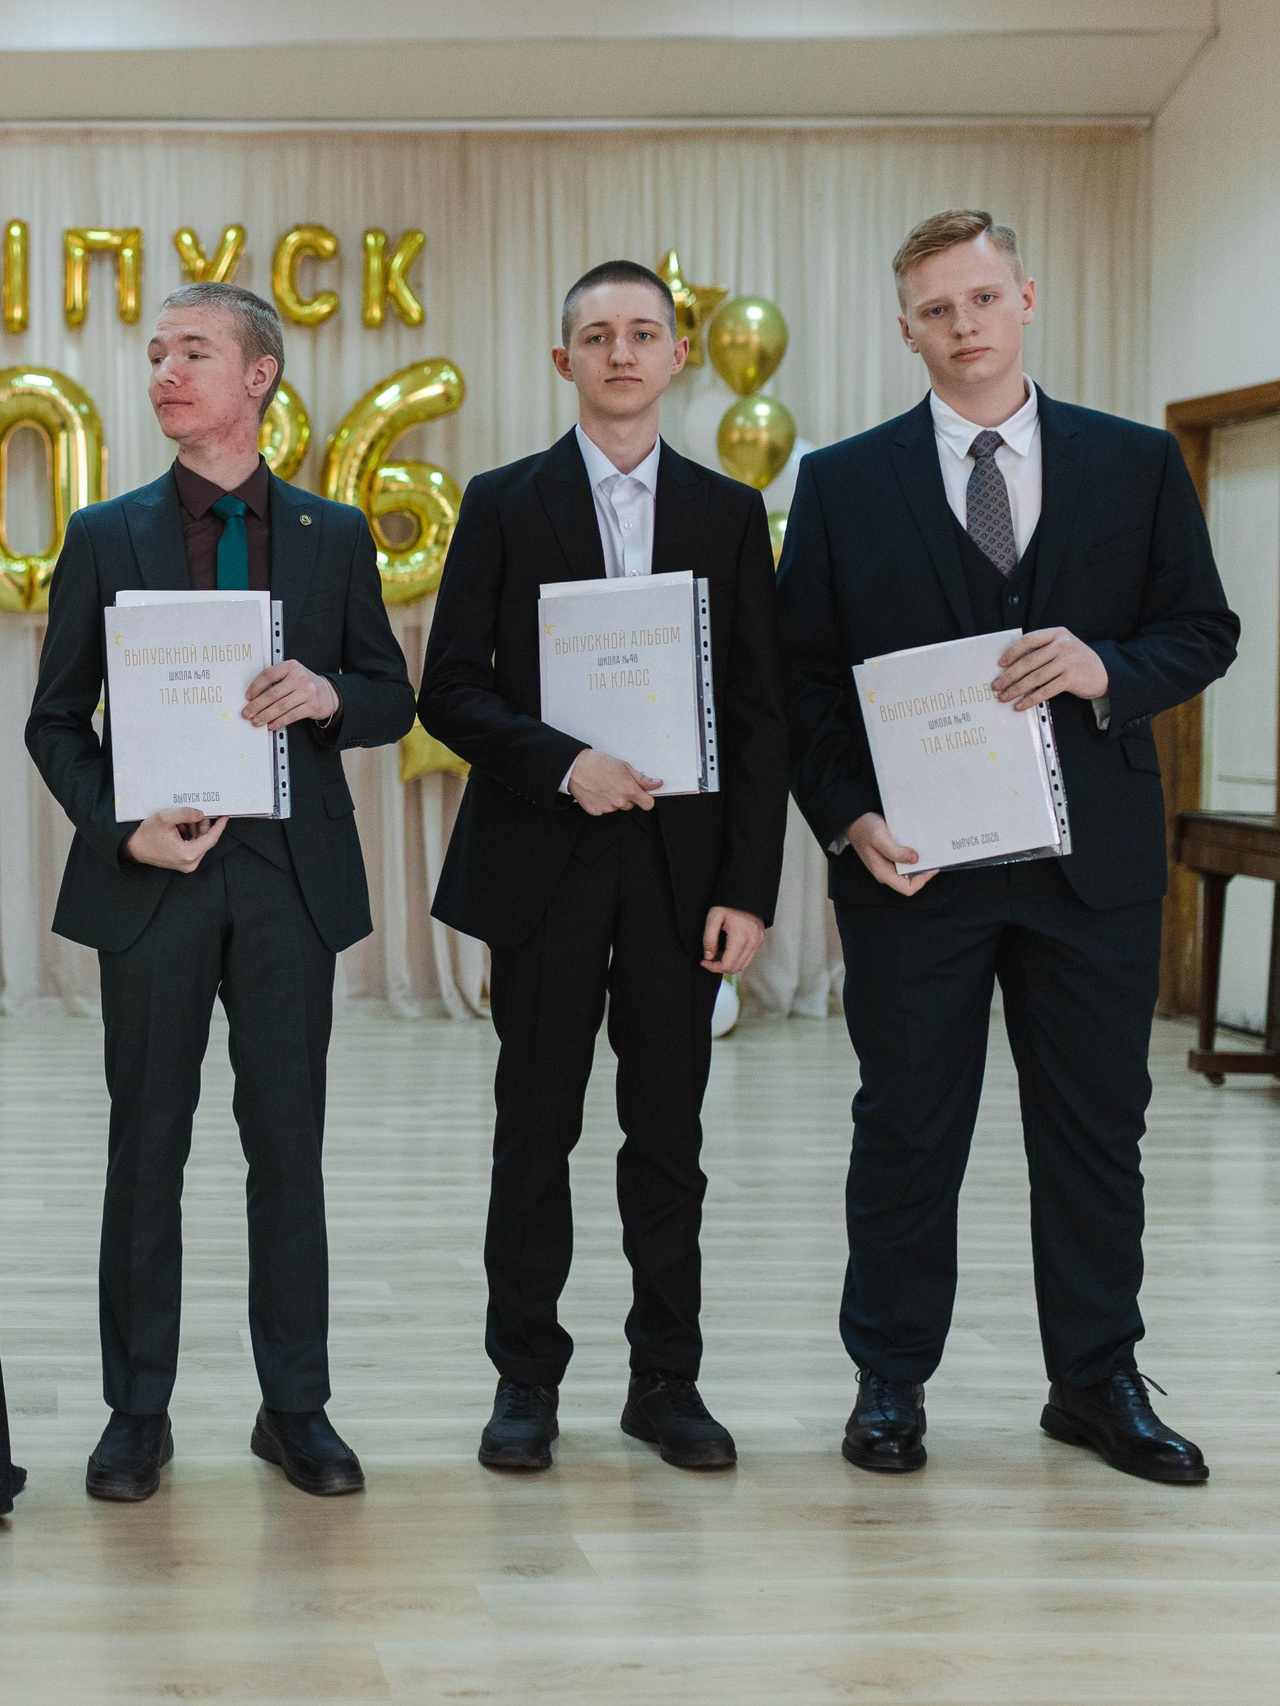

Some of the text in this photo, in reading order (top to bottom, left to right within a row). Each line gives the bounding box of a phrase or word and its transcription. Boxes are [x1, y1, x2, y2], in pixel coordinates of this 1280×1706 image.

[555, 627, 681, 655] ВЫПУСКНОЙ АЛЬБОМ
[124, 643, 252, 666] ВЫПУСКНОЙ АЛЬБОМ
[597, 654, 639, 666] ШКОЛА №46
[168, 670, 210, 681] ШКОЛА №46
[588, 669, 650, 690] 11А КЛАСС
[159, 686, 223, 705] 11А КЛАСС
[879, 683, 1000, 723] ВЫПУСКНОЙ АЛЬБ
[928, 712, 971, 730] ШКОЛА №46
[921, 727, 987, 756] 11А КЛАСС
[173, 792, 220, 804] ВЫПУСК 2026
[951, 832, 999, 850] ВЫПУСК 2026
